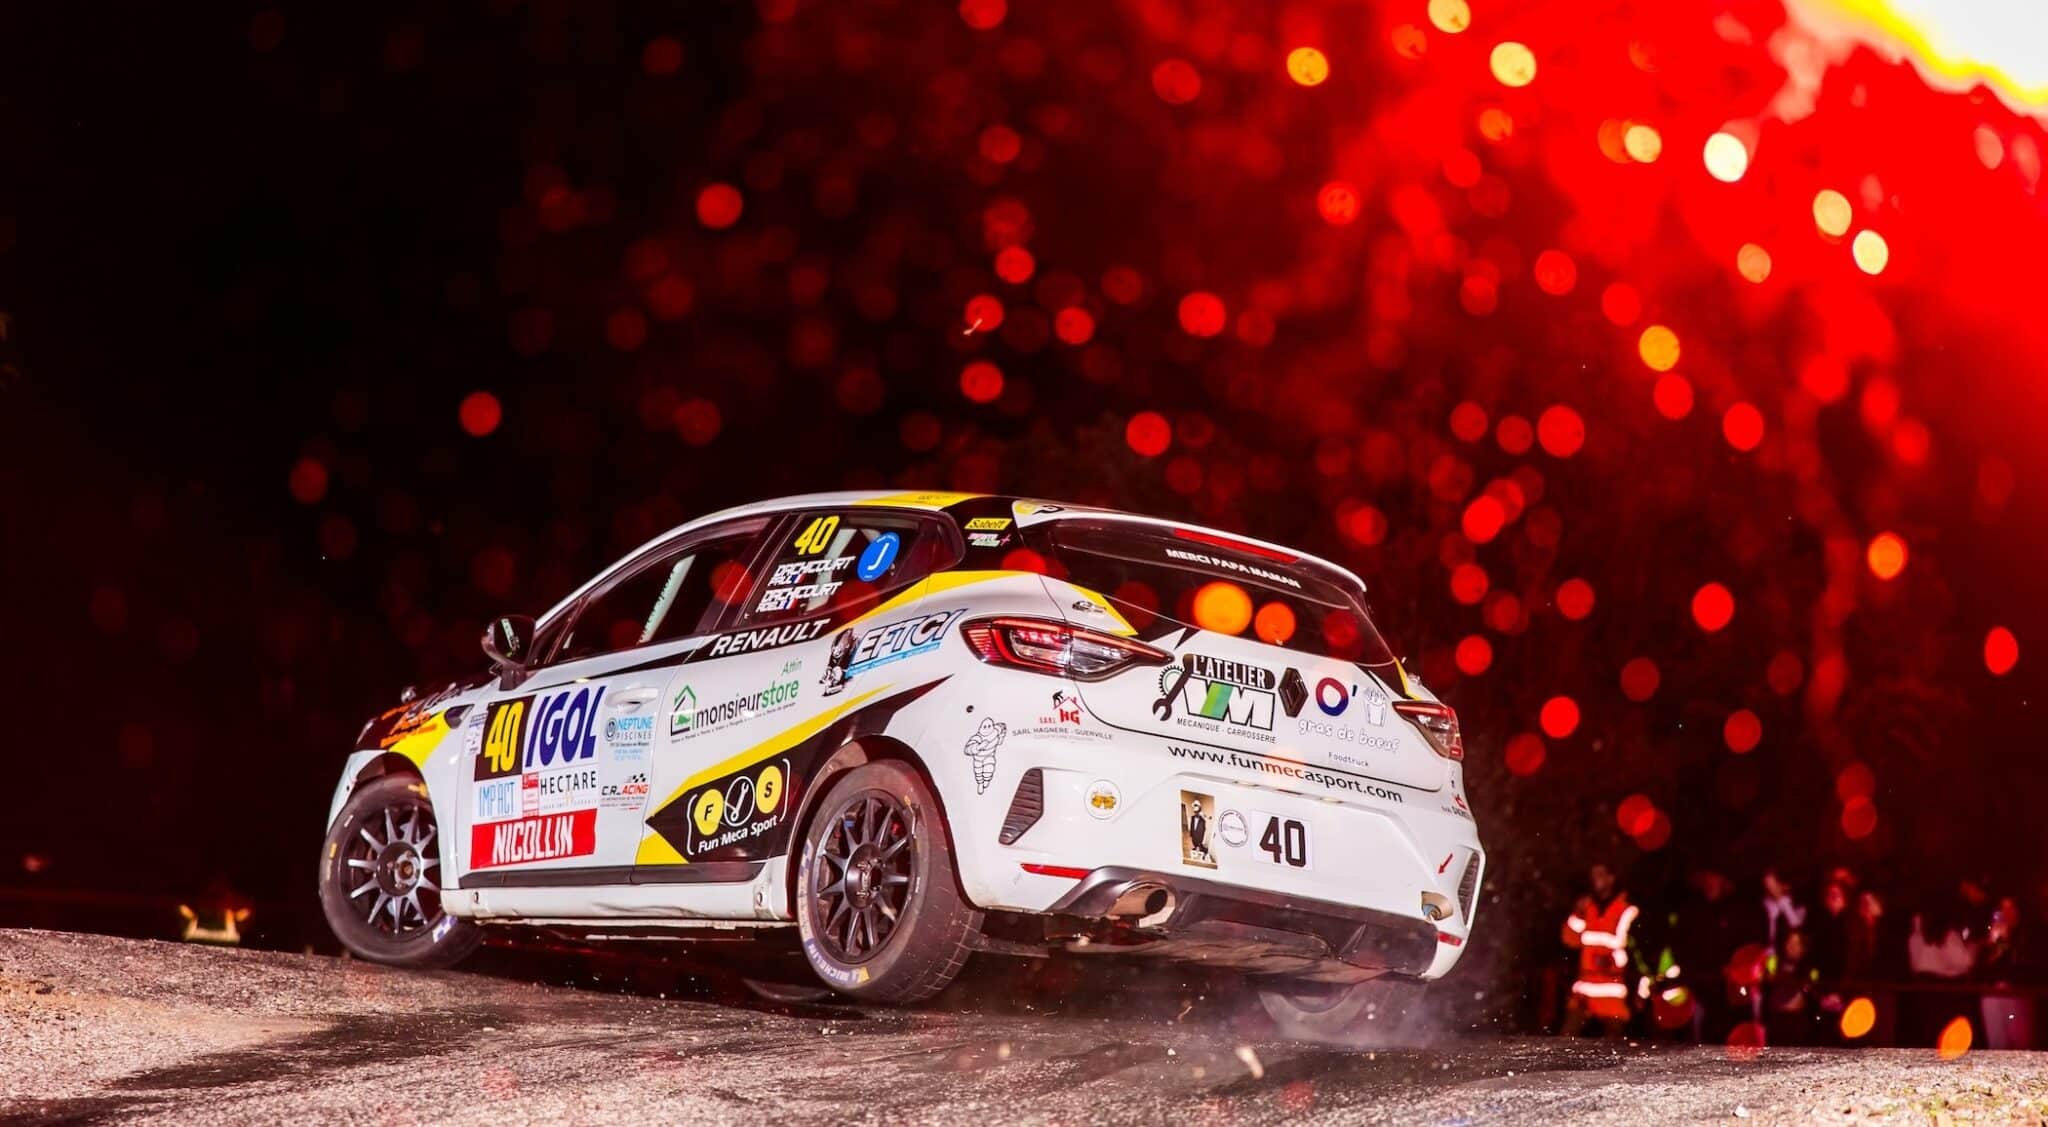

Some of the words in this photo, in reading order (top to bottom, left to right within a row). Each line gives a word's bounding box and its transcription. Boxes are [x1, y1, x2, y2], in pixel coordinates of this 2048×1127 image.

[794, 515, 840, 555] 40
[867, 543, 889, 570] J
[1165, 549, 1210, 565] MERCI
[1211, 557, 1250, 574] PAPA
[709, 619, 831, 656] RENAULT
[850, 608, 968, 666] EFTCI
[1192, 654, 1267, 688] L'ATELIER
[696, 680, 799, 729] monsieurstore
[1059, 708, 1081, 726] HG
[483, 700, 525, 773] 40
[524, 686, 606, 768] IGOL
[615, 730, 652, 741] PISCINES
[617, 715, 654, 731] NEPTUNE
[1177, 717, 1220, 733] MECANIQUE
[1226, 726, 1277, 744] CARROSSERIE
[1298, 719, 1333, 736] gras
[1337, 724, 1354, 742] de
[540, 771, 597, 796] HECTARE
[763, 781, 773, 798] S
[1168, 746, 1404, 804] www.funmecasport.com
[479, 781, 516, 817] IMPACT
[704, 803, 714, 822] F
[492, 814, 575, 865] NICOLLIN
[698, 838, 720, 854] Fun
[721, 827, 749, 846] Meca
[750, 814, 778, 837] Sport
[1260, 815, 1306, 868] 40
